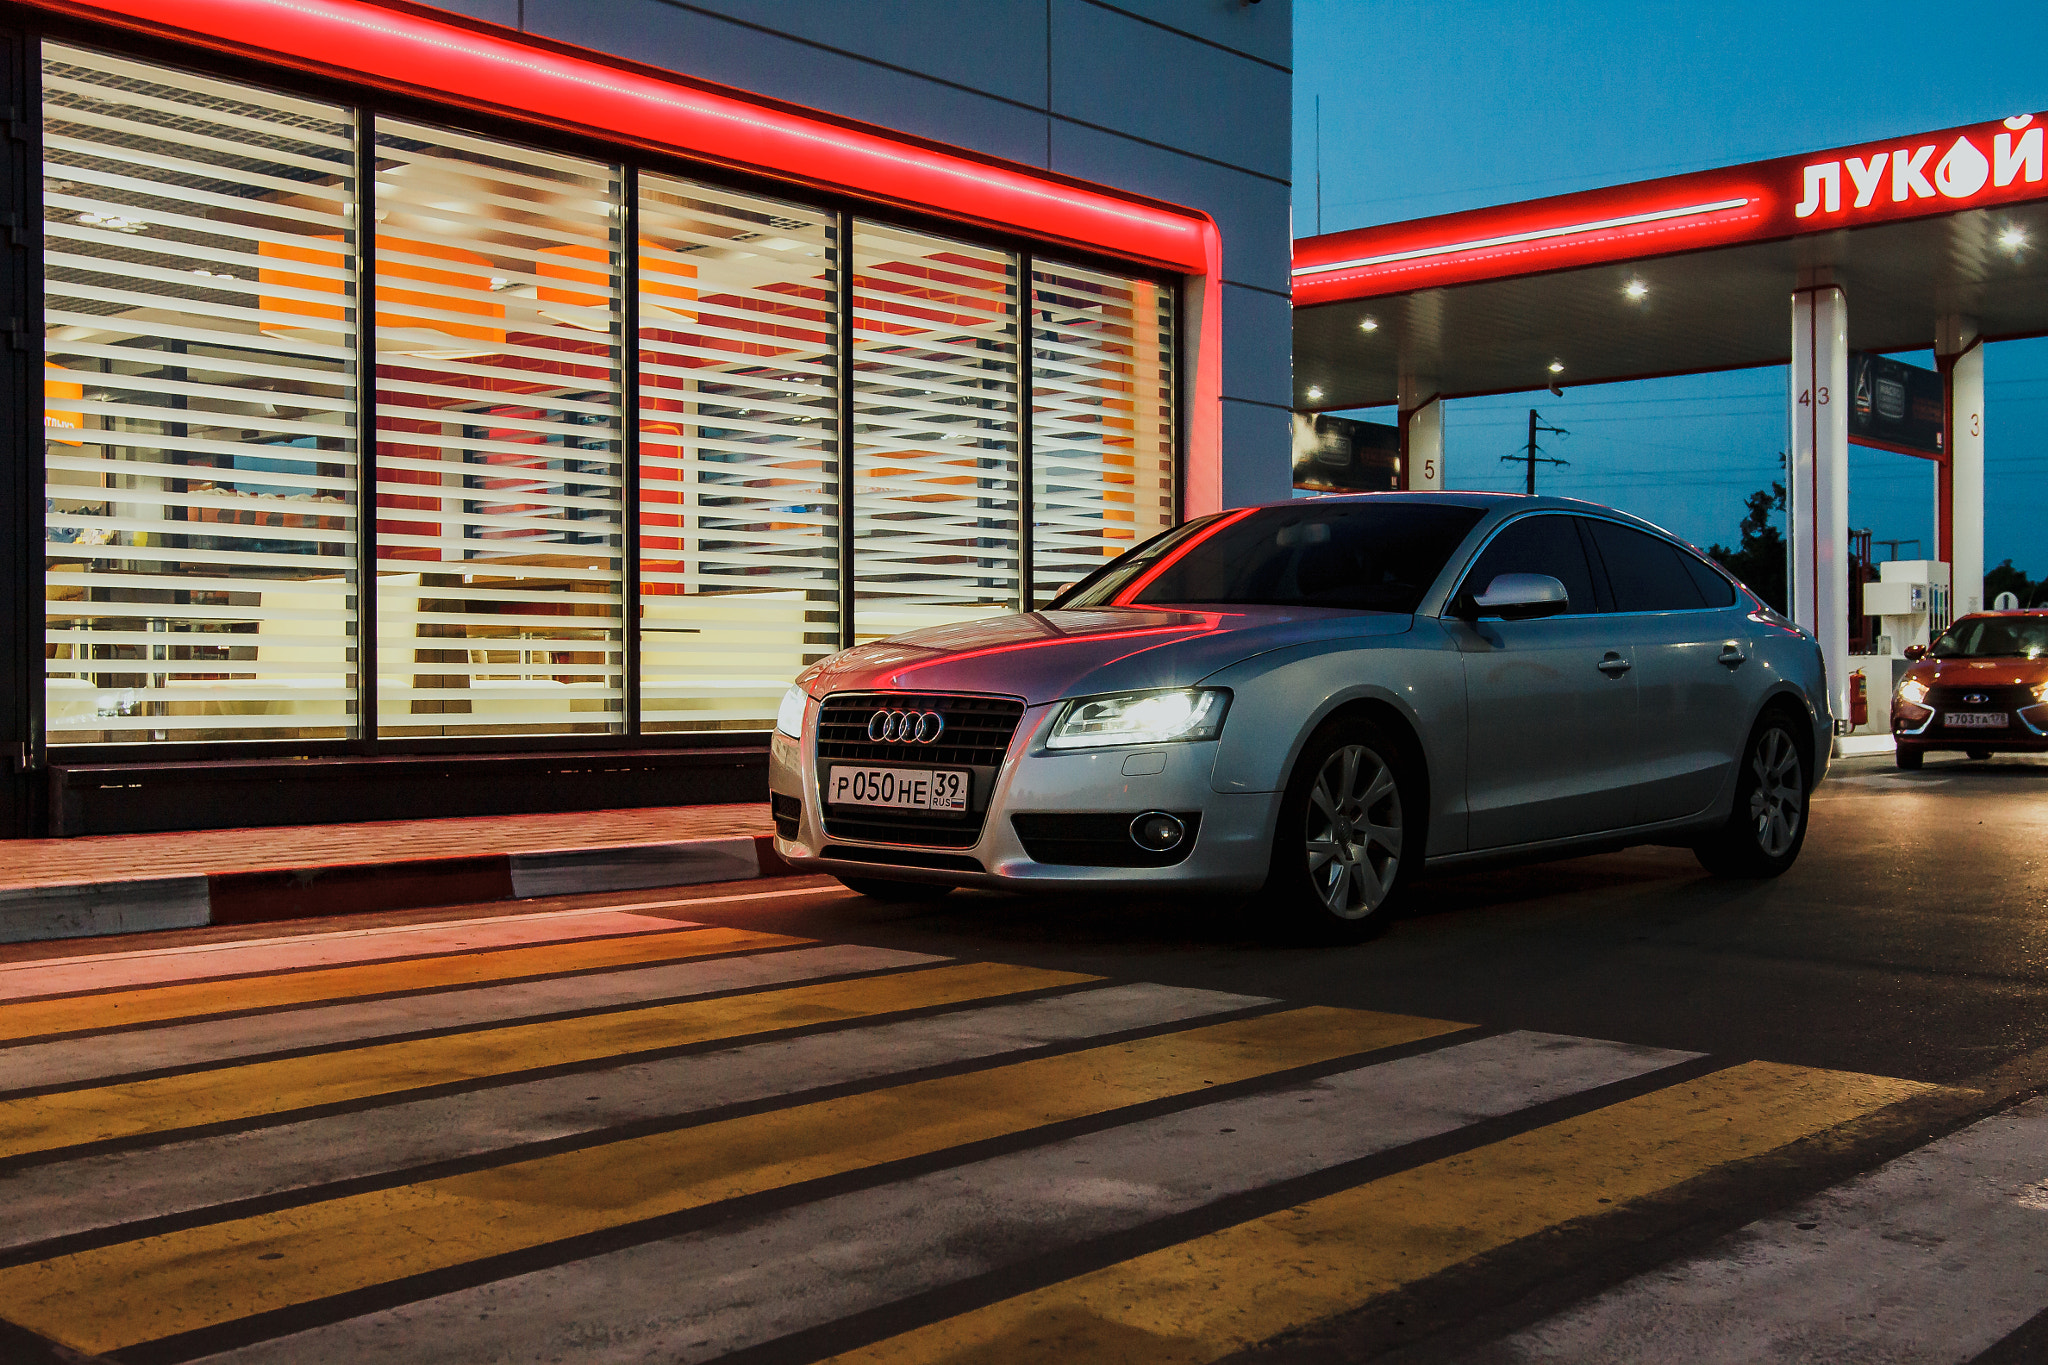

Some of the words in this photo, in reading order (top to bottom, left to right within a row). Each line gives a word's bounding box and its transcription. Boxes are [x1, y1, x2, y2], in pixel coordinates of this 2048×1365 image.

[1798, 389, 1811, 407] 4
[1818, 386, 1830, 405] 3
[1970, 413, 1980, 437] 3
[1424, 459, 1435, 480] 5
[934, 773, 960, 797] 39
[932, 797, 951, 808] RUS
